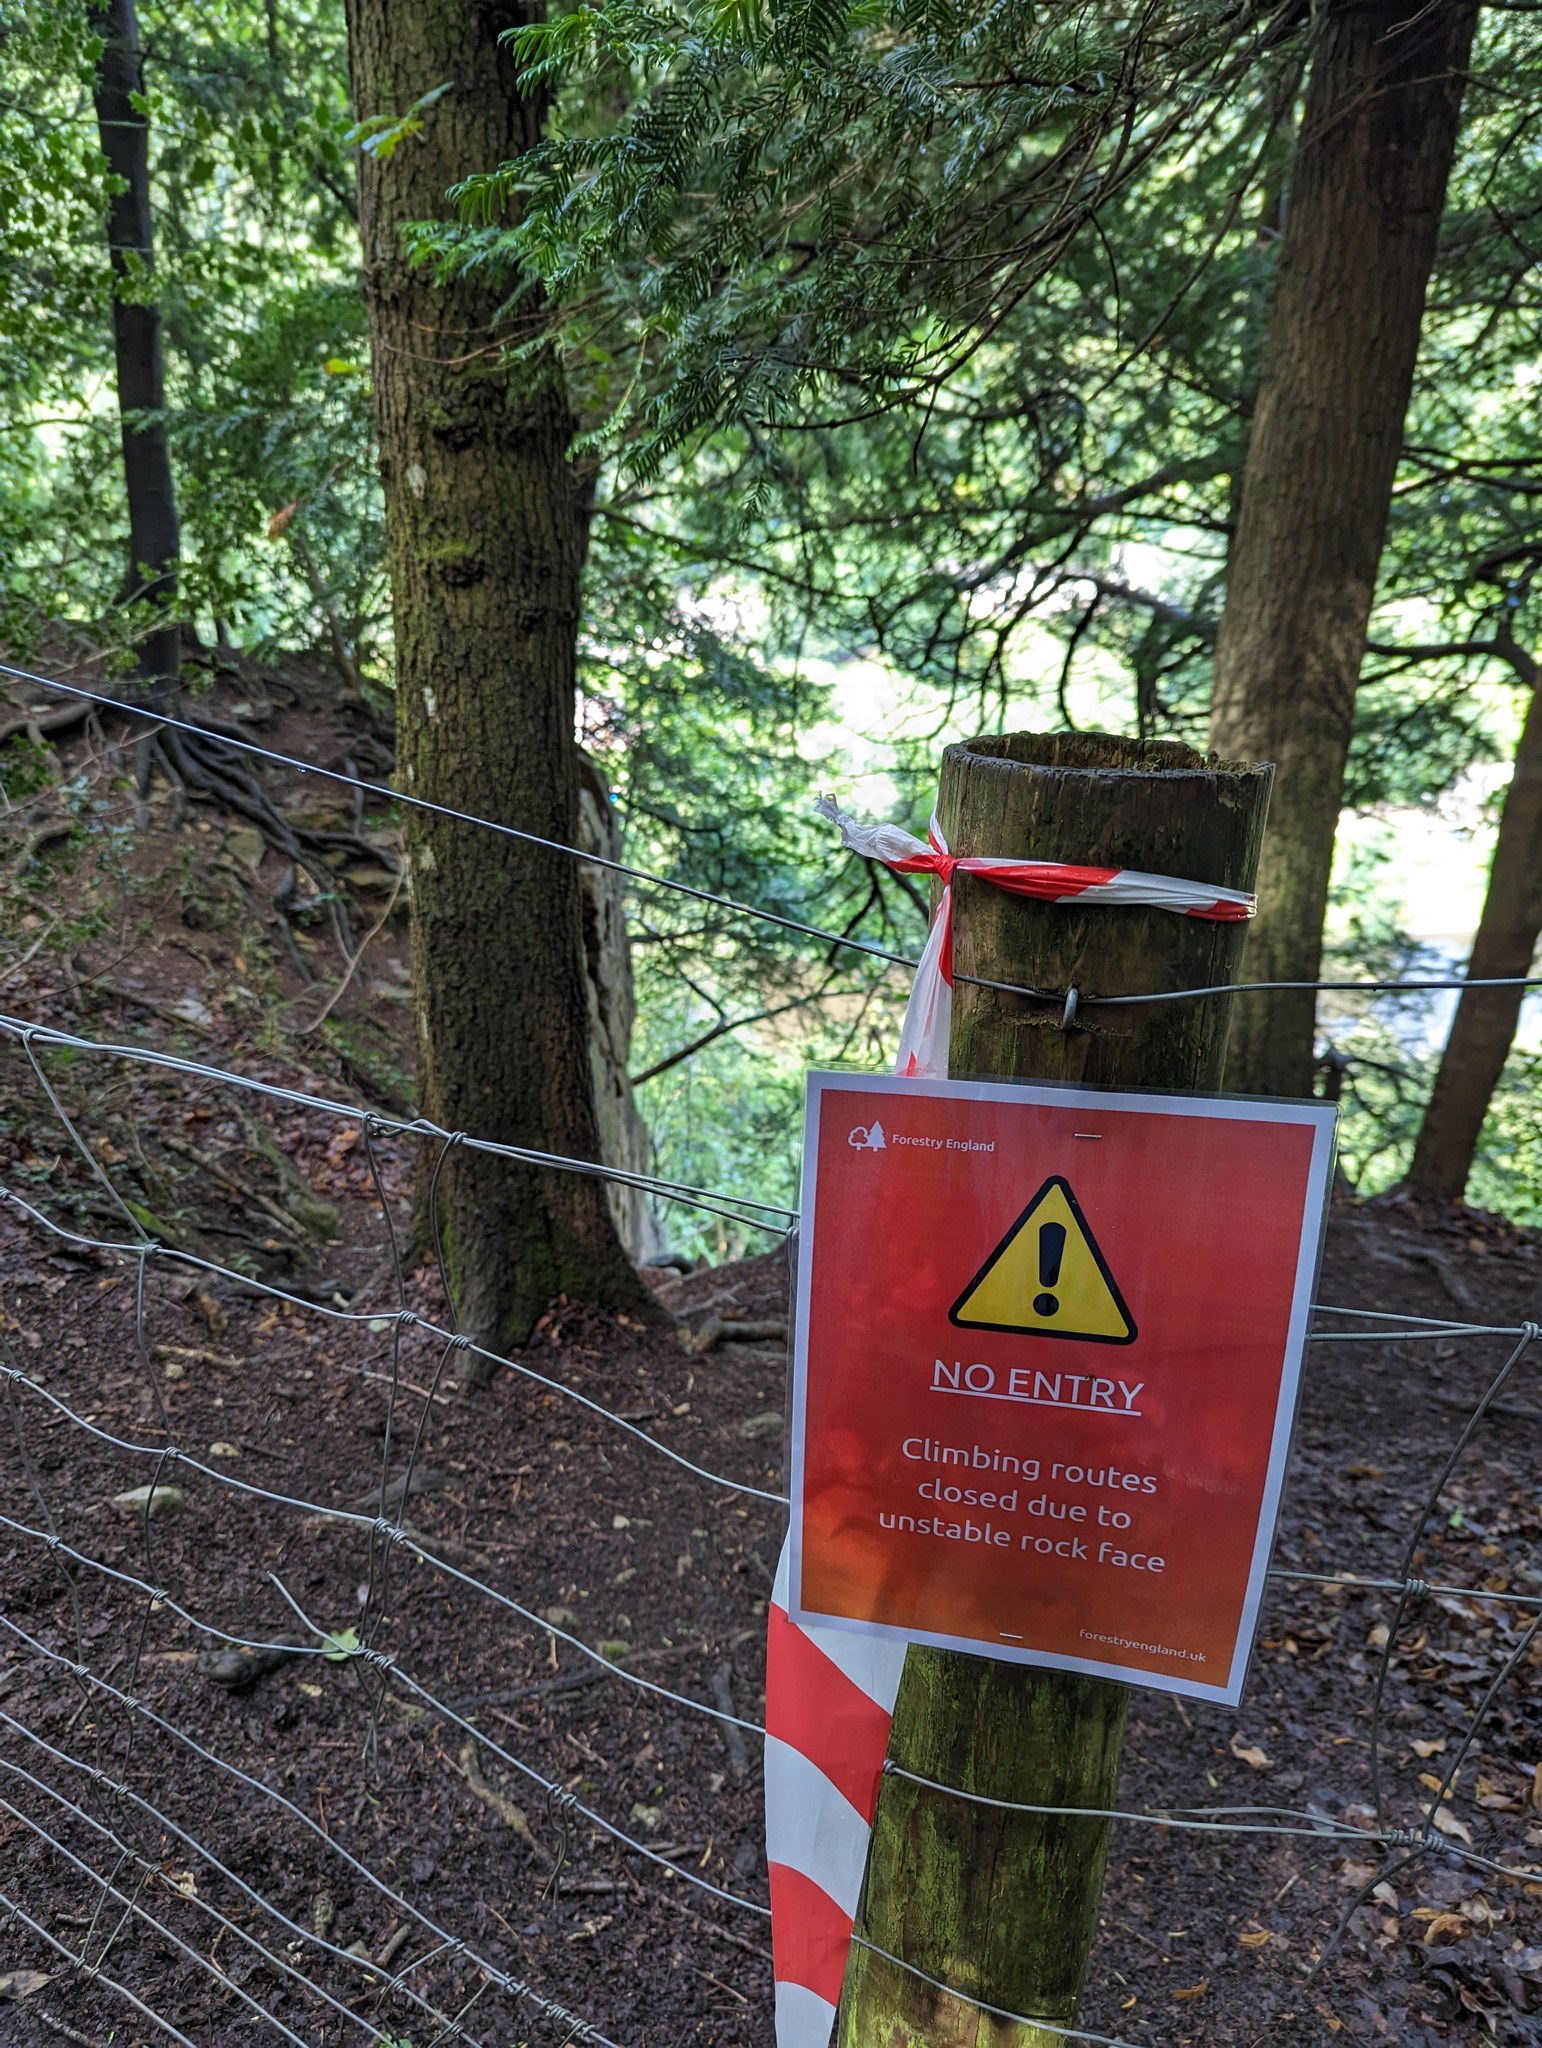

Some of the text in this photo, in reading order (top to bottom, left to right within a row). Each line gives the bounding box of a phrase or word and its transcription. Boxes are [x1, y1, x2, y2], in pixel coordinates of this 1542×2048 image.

[892, 1134, 995, 1152] Forestry England
[932, 1359, 1145, 1410] NO ENTRY
[902, 1437, 1157, 1494] Climbing routes
[918, 1478, 1131, 1529] closed due to
[879, 1512, 1165, 1573] unstable rock face
[1079, 1628, 1207, 1663] forestryengland.uk
